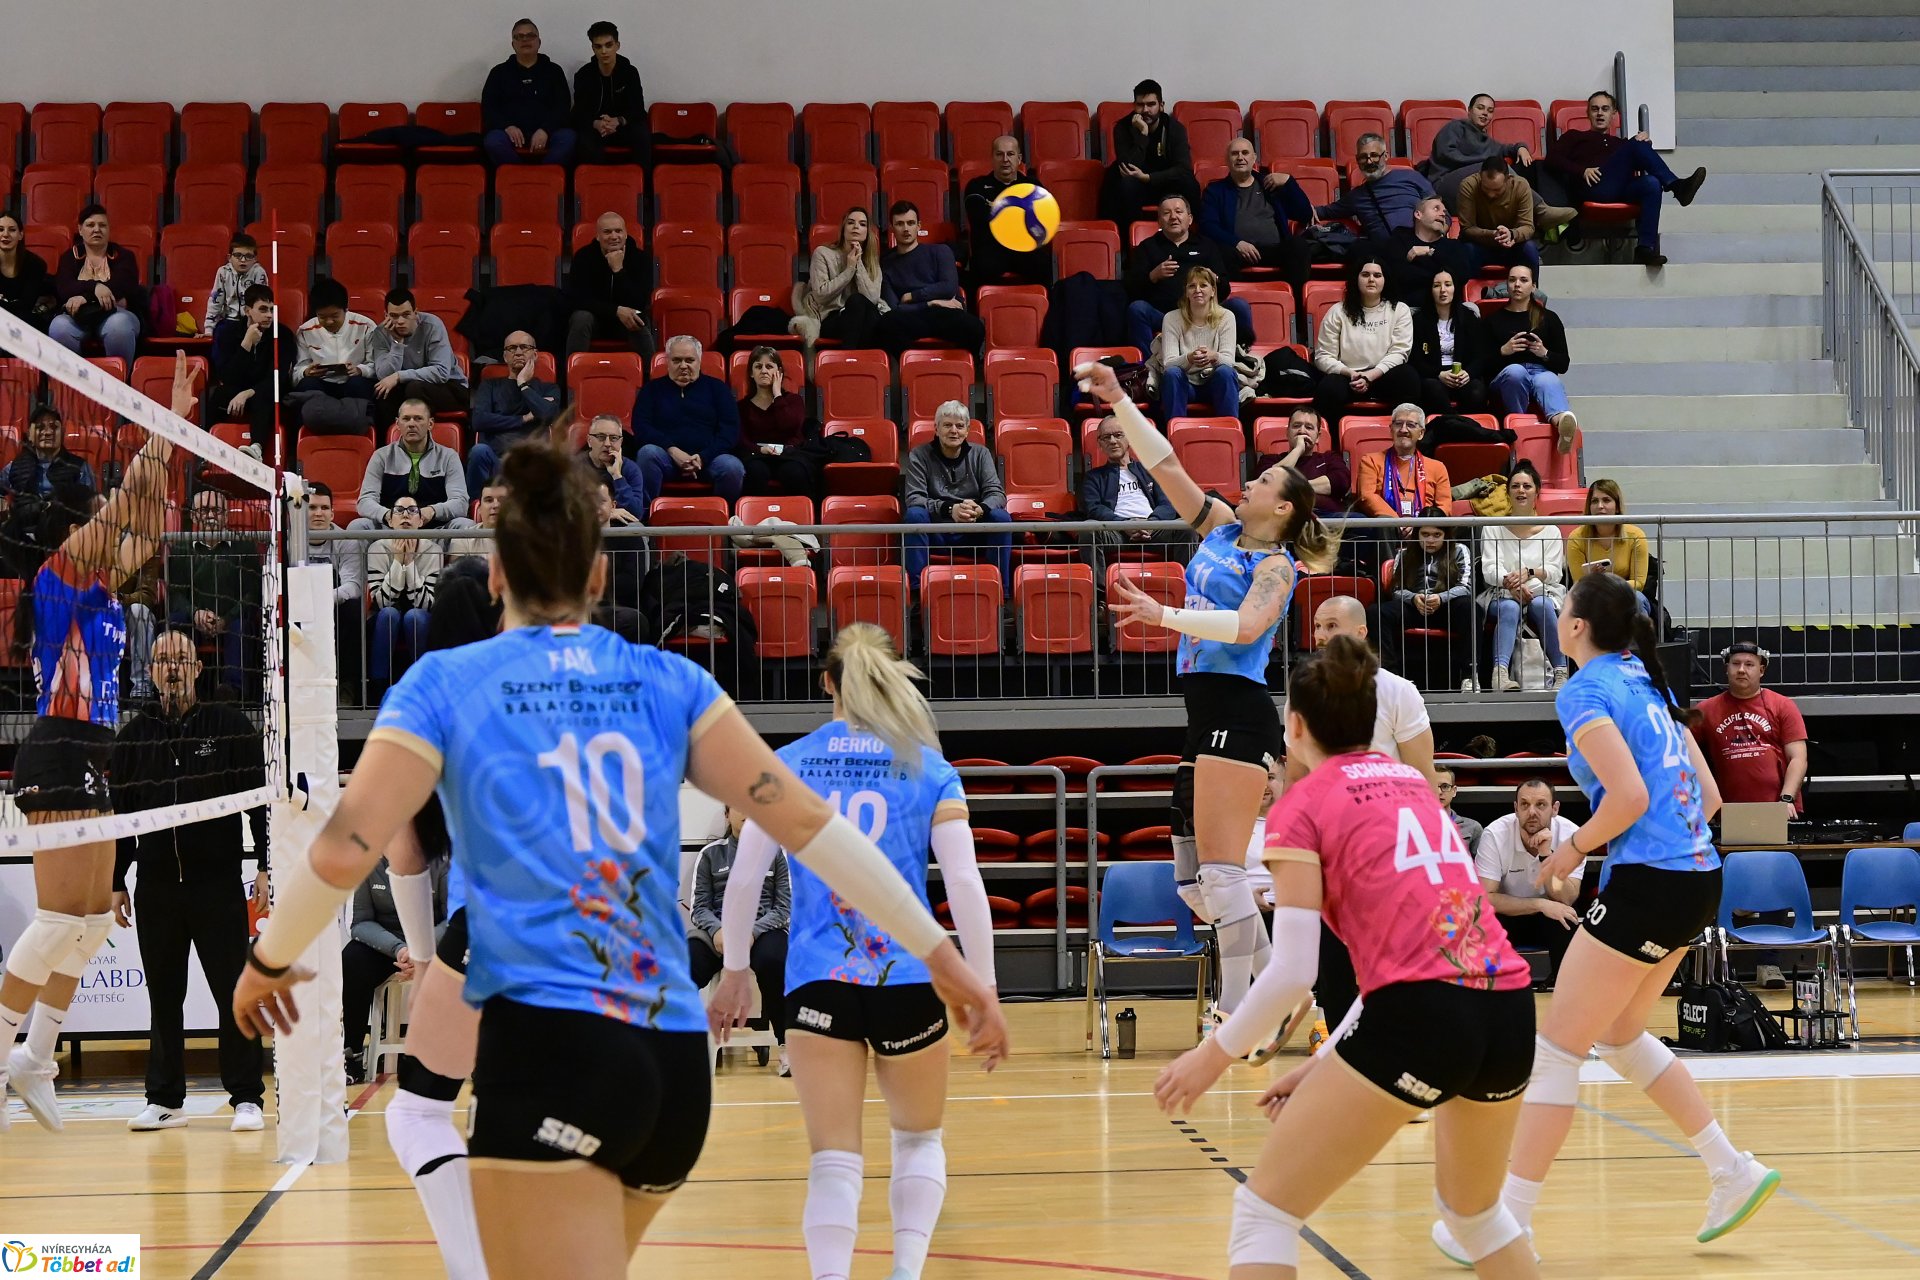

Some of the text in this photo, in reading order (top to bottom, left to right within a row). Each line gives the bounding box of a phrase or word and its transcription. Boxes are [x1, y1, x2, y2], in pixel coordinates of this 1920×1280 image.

[1194, 561, 1215, 594] 11
[1716, 711, 1772, 734] PACIFIC SAILING
[1211, 729, 1228, 749] 11
[801, 757, 841, 767] SZENT
[537, 731, 647, 853] 10
[1394, 807, 1480, 886] 44
[1586, 897, 1607, 925] 20
[87, 955, 117, 965] GYAR
[81, 969, 144, 988] LABD
[797, 1006, 833, 1028] SDG
[1683, 1002, 1708, 1023] SELECT
[537, 1117, 602, 1157] SDG
